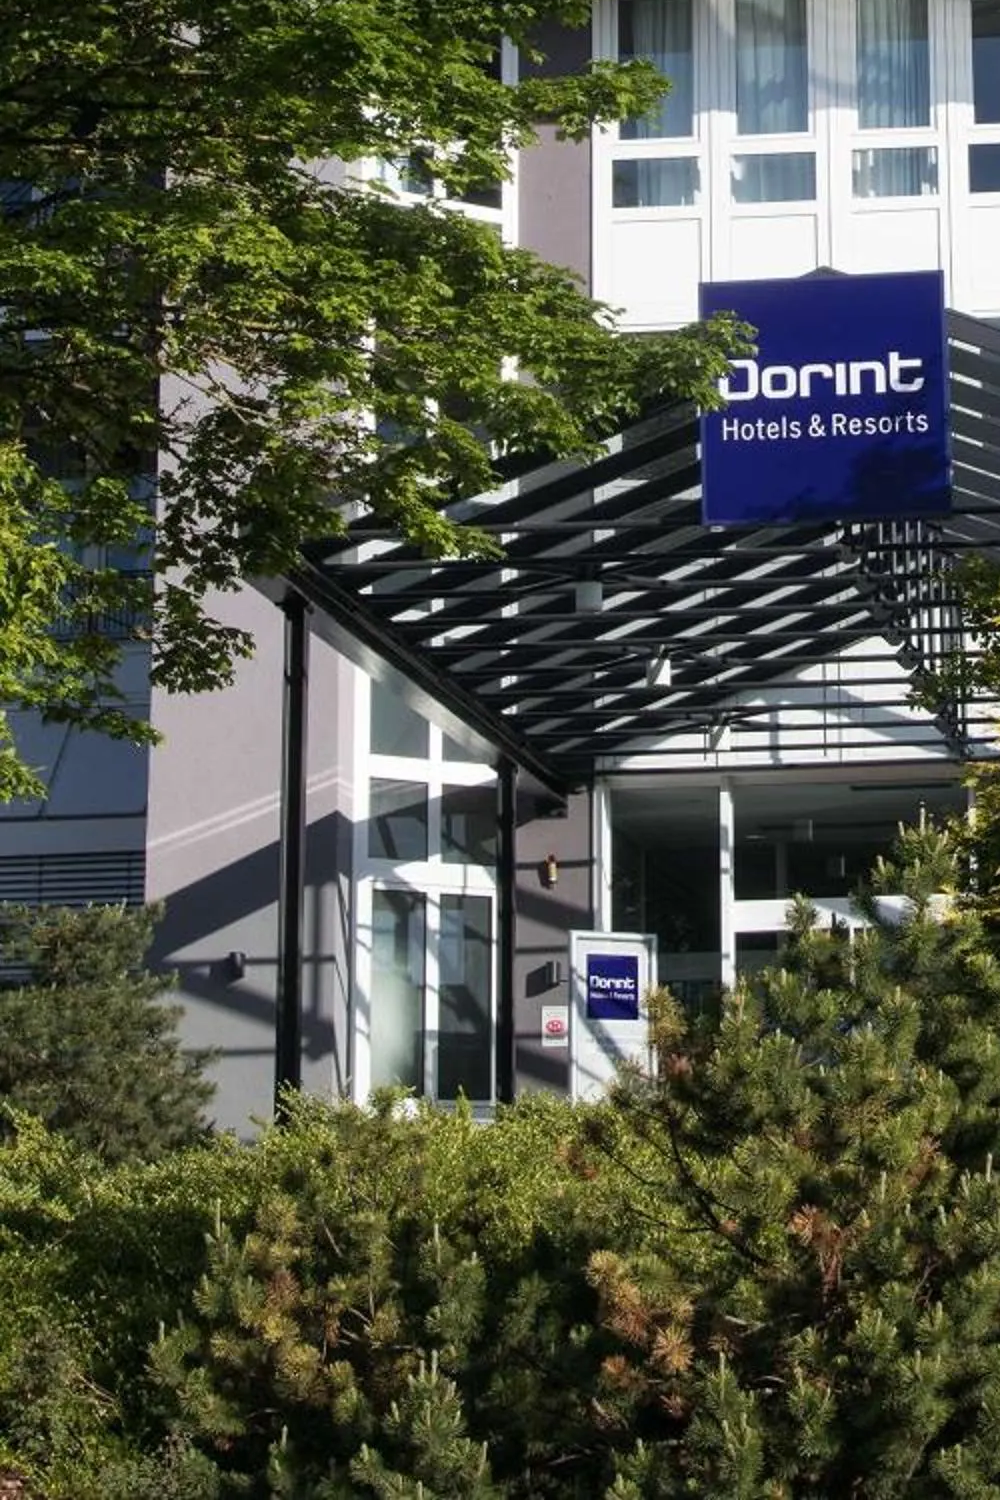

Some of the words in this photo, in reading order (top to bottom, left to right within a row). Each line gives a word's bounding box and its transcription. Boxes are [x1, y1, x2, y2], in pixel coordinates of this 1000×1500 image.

[718, 351, 925, 401] Dorint
[722, 416, 801, 440] Hotels
[808, 414, 826, 437] &
[831, 410, 929, 436] Resorts
